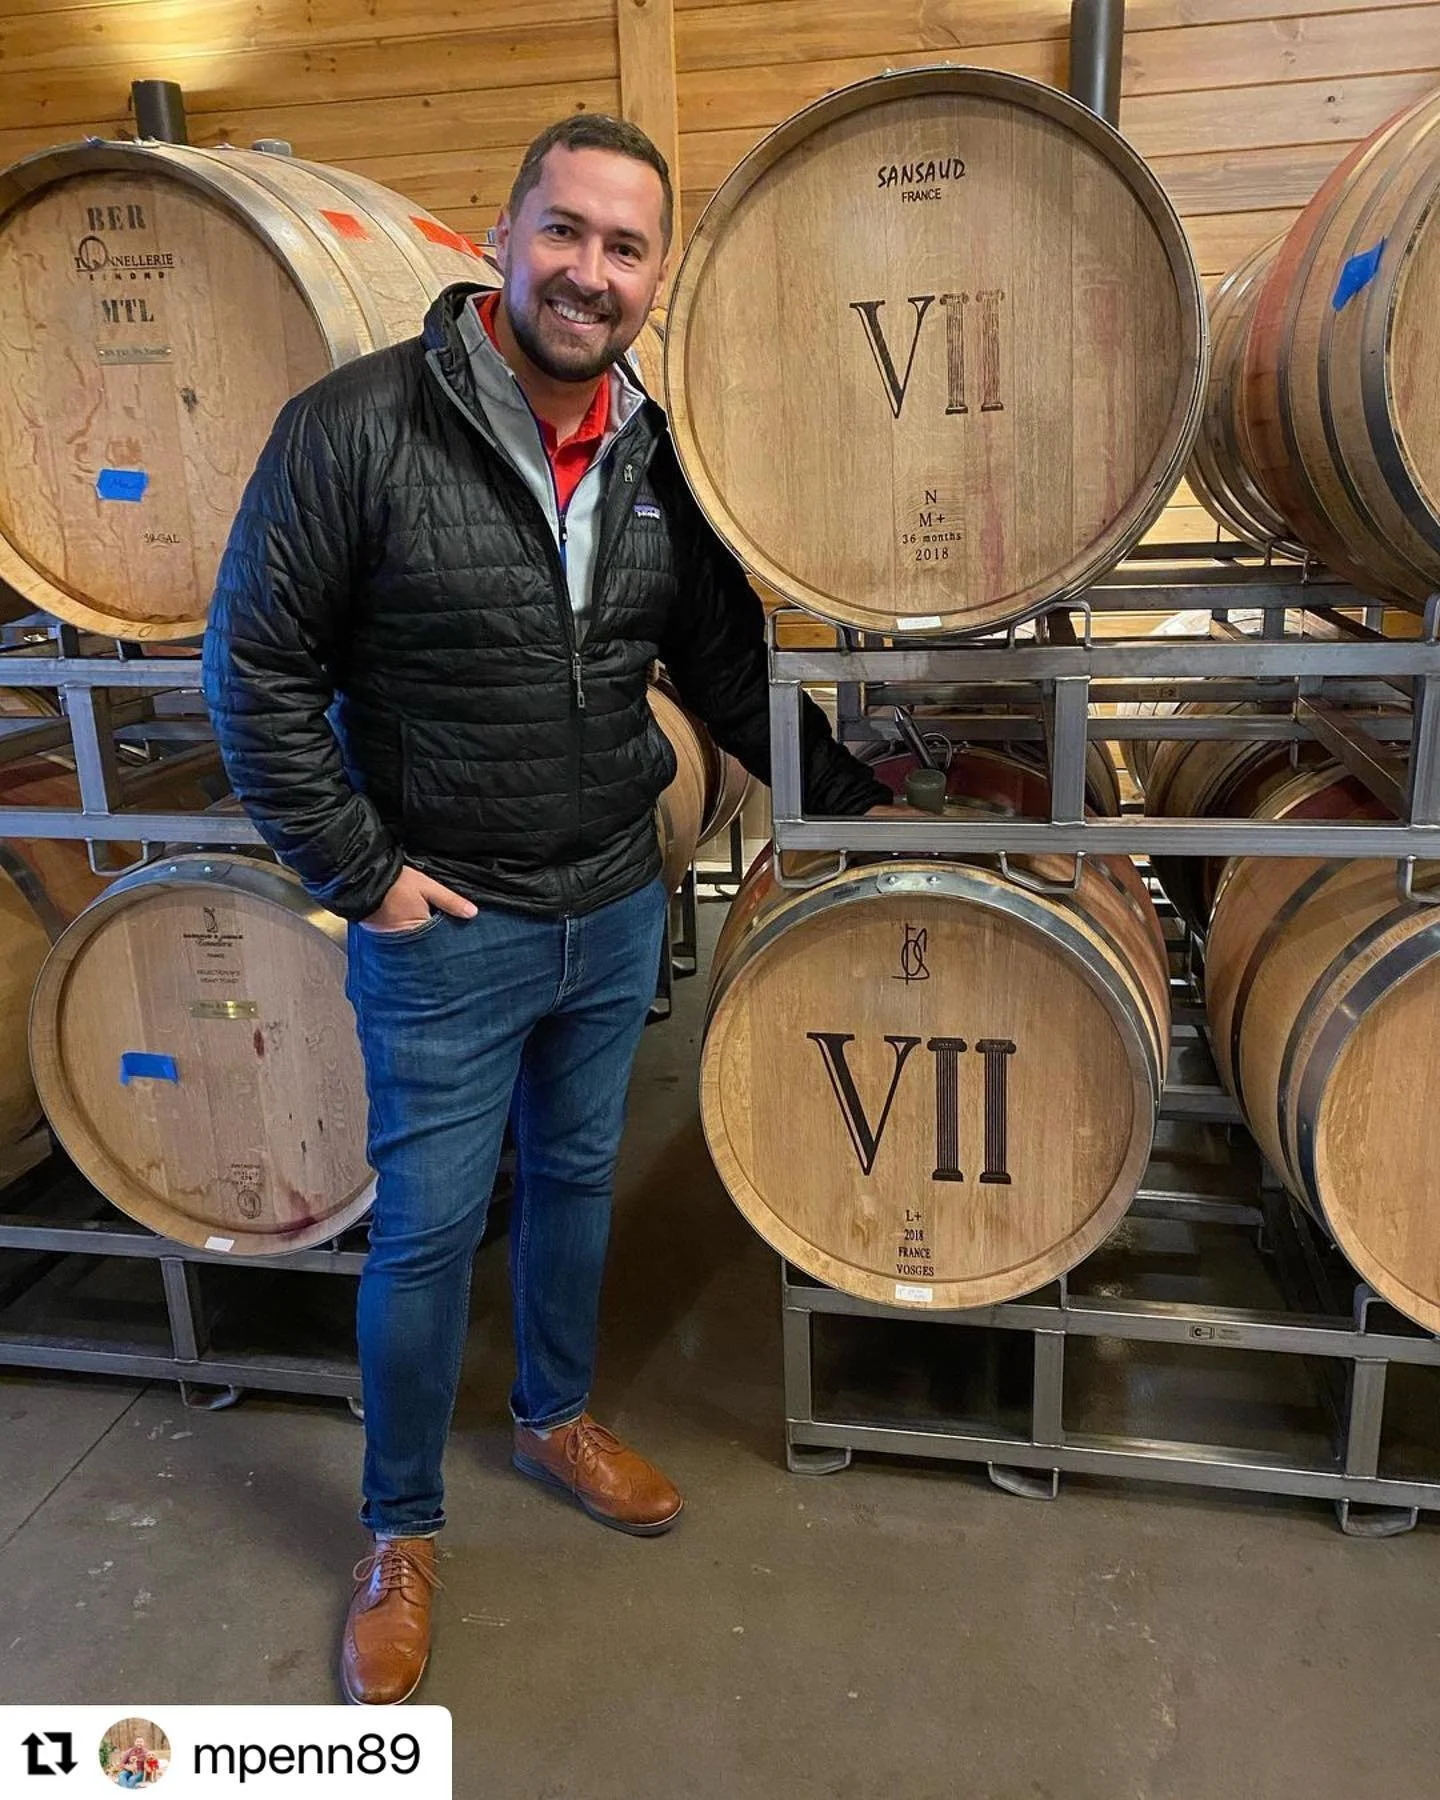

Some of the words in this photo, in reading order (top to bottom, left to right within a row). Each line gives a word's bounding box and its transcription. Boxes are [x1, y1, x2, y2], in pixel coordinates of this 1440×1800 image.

[878, 158, 966, 188] SANSAUD
[901, 188, 942, 203] FRANCE
[87, 204, 146, 231] BER
[102, 298, 154, 323] MTL
[849, 290, 1005, 419] VII
[924, 489, 937, 505] N
[902, 533, 917, 545] 36
[922, 532, 962, 543] months
[915, 547, 949, 561] 2018
[806, 1031, 1017, 1185] VII
[905, 1209, 922, 1222] L+
[903, 1228, 924, 1241] 2018
[898, 1246, 931, 1259] FRANCE
[896, 1263, 935, 1277] VOSGES
